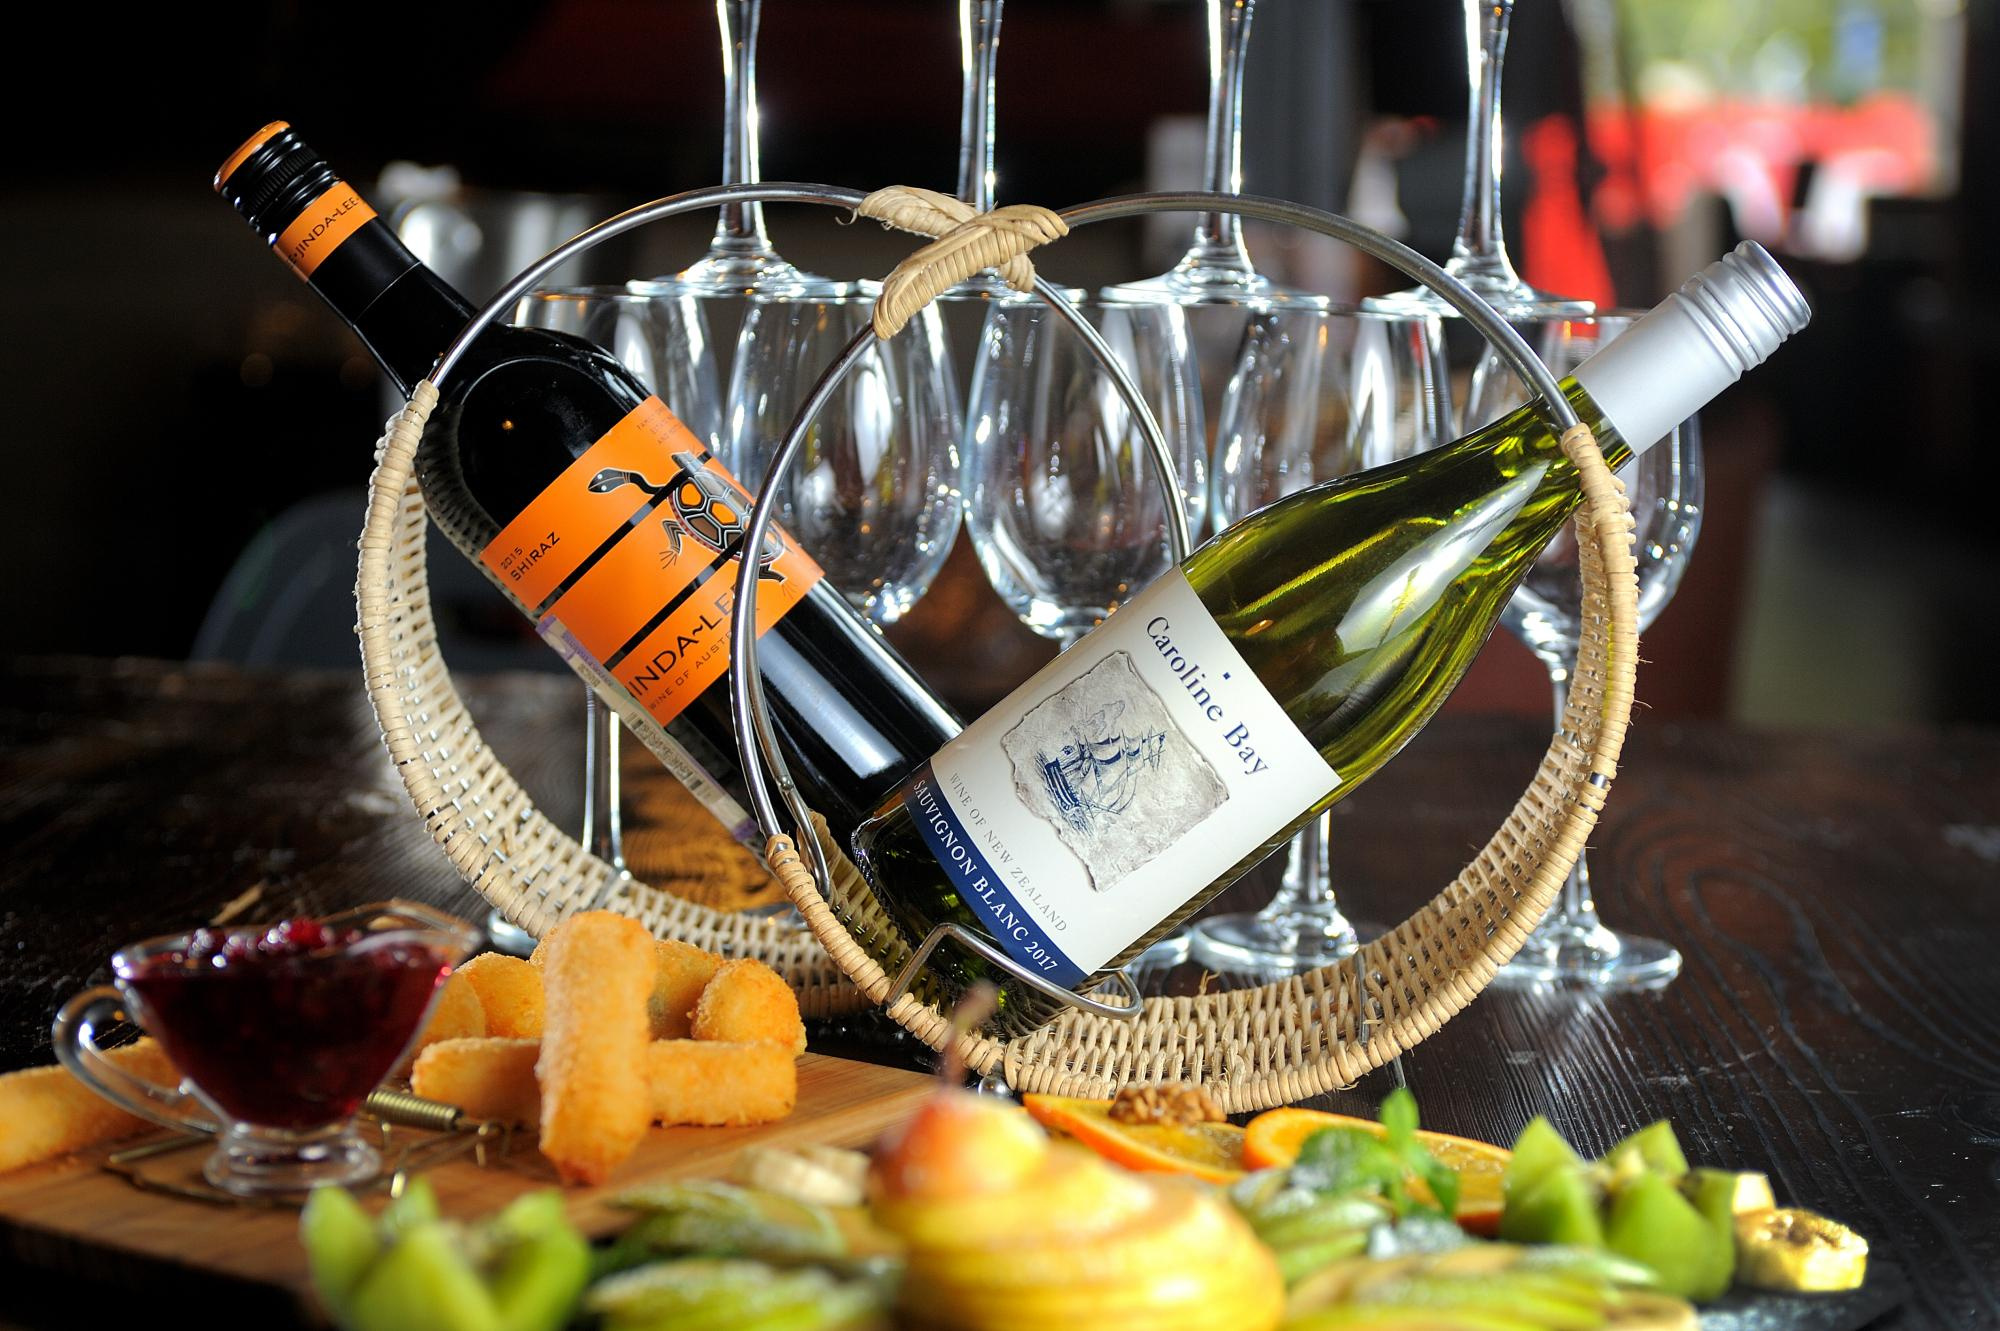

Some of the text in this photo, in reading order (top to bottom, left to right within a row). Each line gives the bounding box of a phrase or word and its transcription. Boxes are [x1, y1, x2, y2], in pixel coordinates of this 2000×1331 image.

[501, 547, 523, 570] 2015
[510, 531, 560, 581] SHIRAZ
[627, 584, 737, 697] INDA~LE
[675, 669, 689, 686] OF
[1146, 616, 1269, 775] Caroline Bay
[913, 779, 978, 876] SAUVIGNON
[972, 876, 1029, 941] BLANC
[1024, 941, 1058, 971] 2017
[950, 772, 1068, 932] WINE OF NEW ZEALAND
